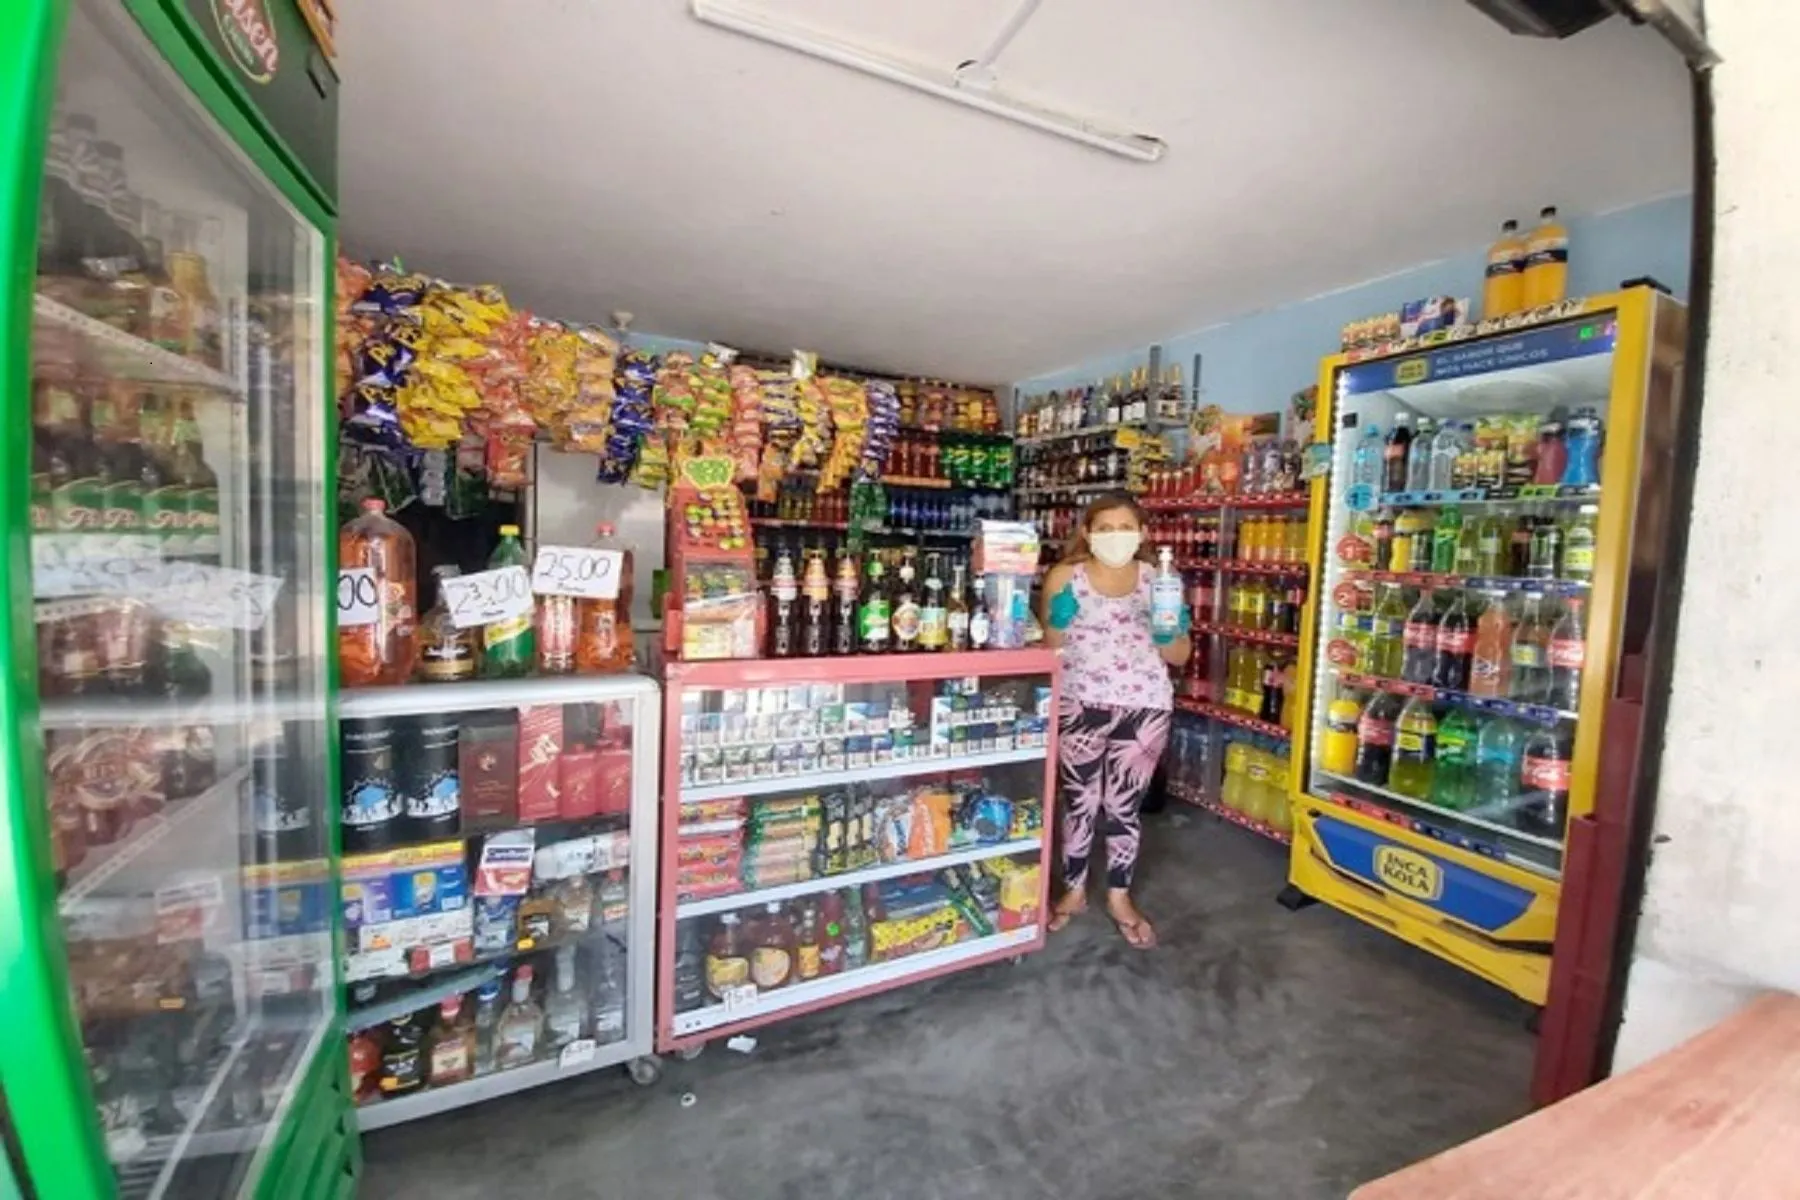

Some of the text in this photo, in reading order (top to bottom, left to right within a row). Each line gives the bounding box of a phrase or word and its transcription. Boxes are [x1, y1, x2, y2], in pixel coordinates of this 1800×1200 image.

[539, 552, 612, 582] 25.00
[1384, 863, 1430, 892] KOLA
[1387, 852, 1428, 878] INCA
